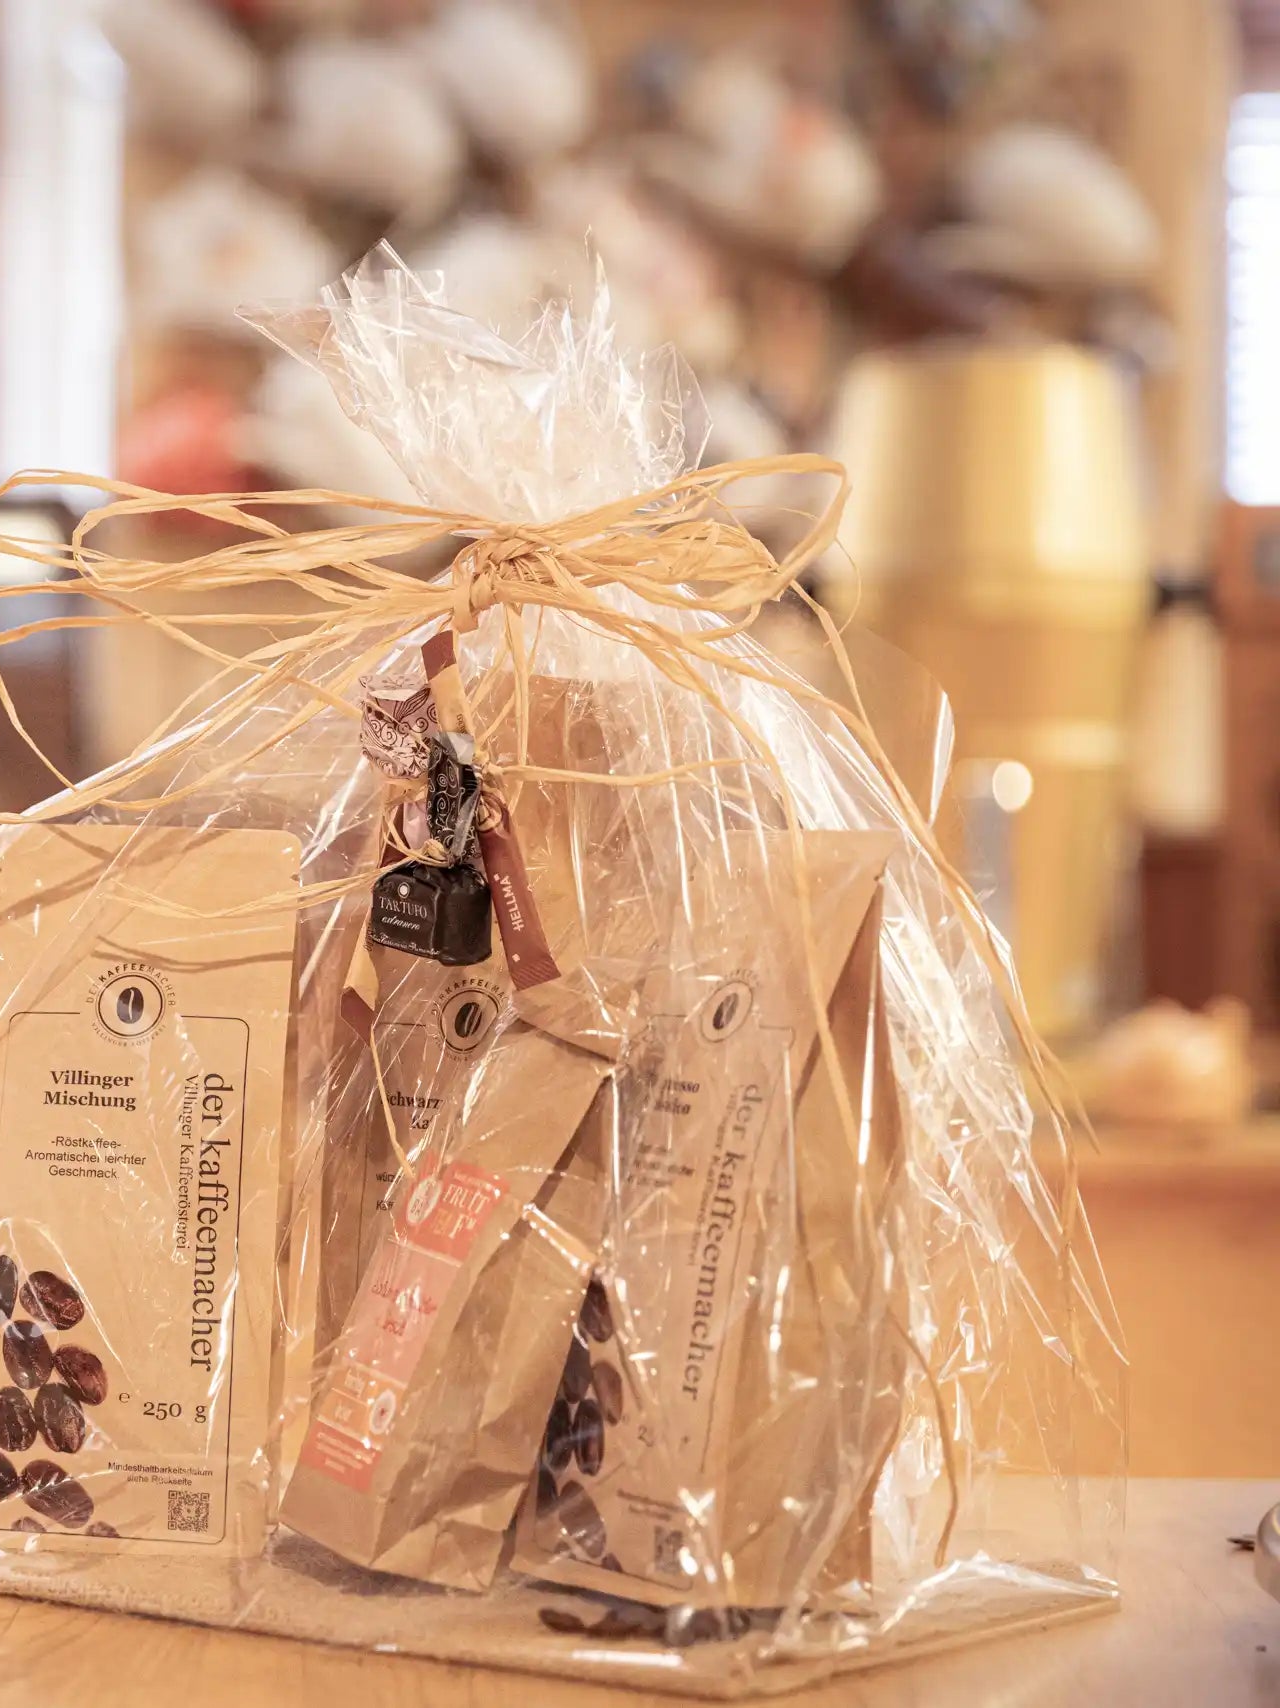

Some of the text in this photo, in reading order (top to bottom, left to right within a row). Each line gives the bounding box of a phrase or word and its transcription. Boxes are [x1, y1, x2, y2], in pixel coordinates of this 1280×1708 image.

[379, 896, 428, 919] TARTUFO
[500, 876, 525, 932] HELLMA
[43, 1090, 137, 1112] Mischung
[49, 1070, 134, 1090] Villinger
[732, 1084, 763, 1141] der
[176, 1074, 200, 1250] Villinger Kaffeerösterei
[190, 1073, 234, 1372] der kaffeemacher
[681, 1152, 746, 1401] kaffeemacher
[143, 1402, 182, 1421] 250
[194, 1405, 207, 1423] g
